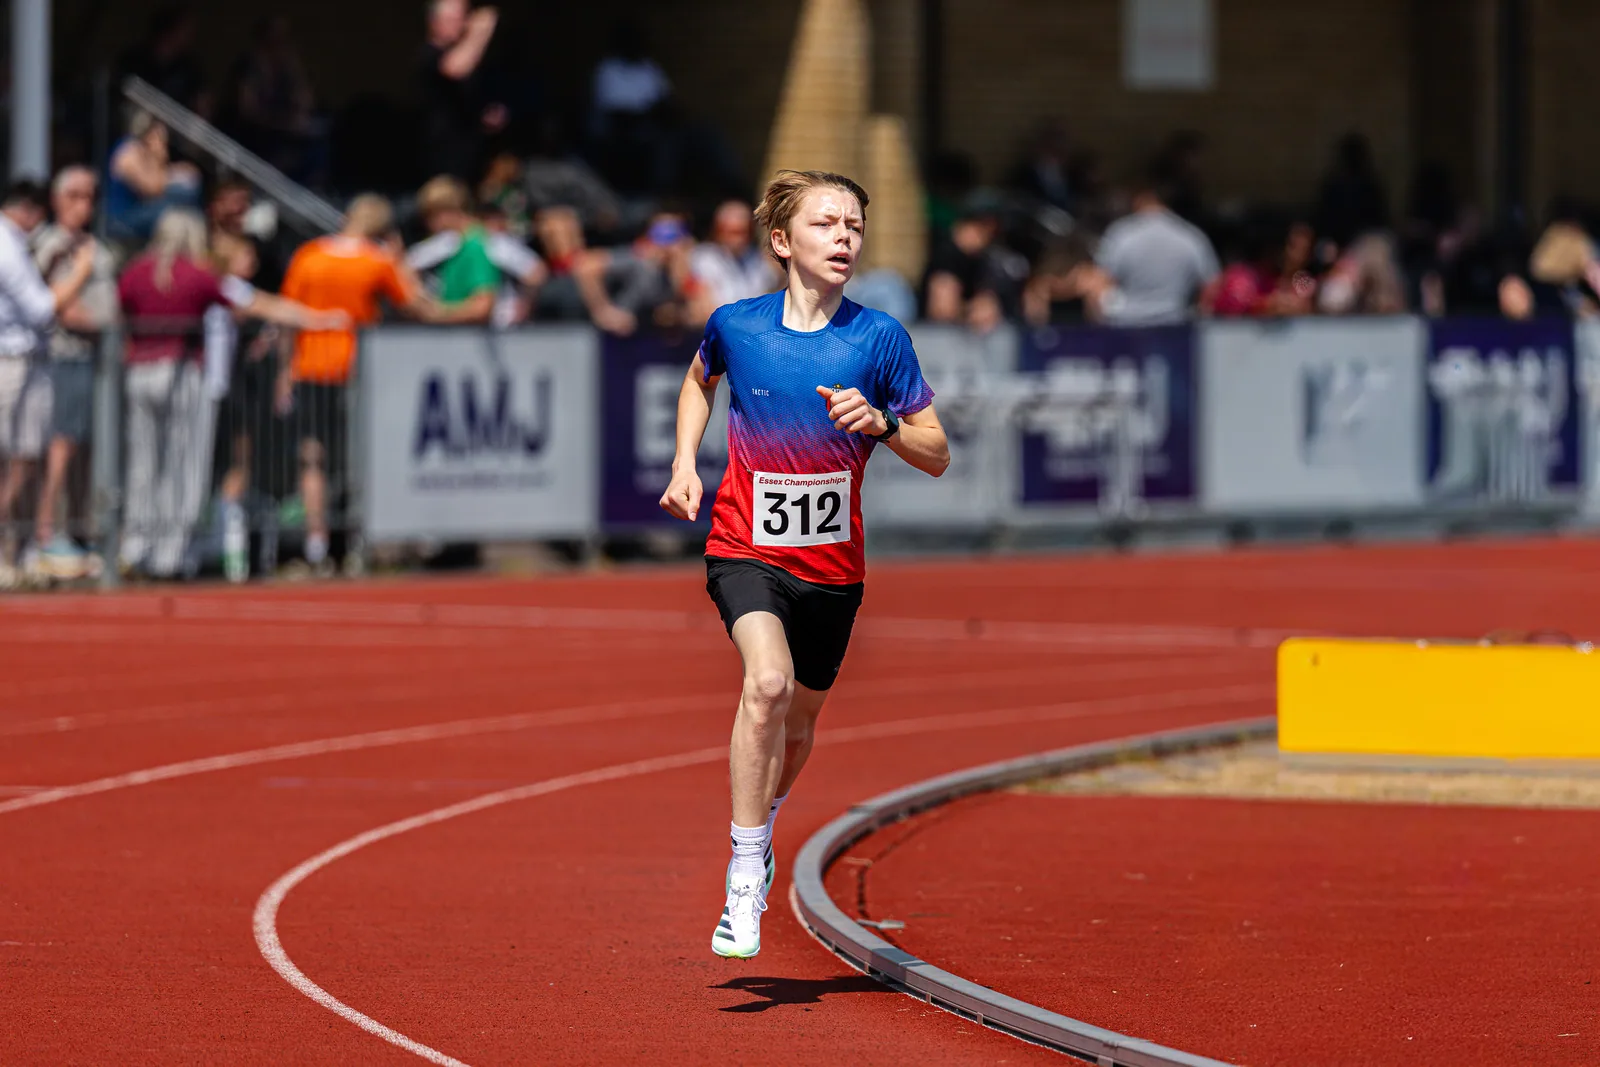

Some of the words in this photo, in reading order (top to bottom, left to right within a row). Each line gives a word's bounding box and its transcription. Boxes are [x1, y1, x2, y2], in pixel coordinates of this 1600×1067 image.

[751, 387, 770, 397] TACTIC
[758, 476, 783, 486] Essex
[784, 476, 847, 487] Championships
[763, 490, 842, 536] 312
